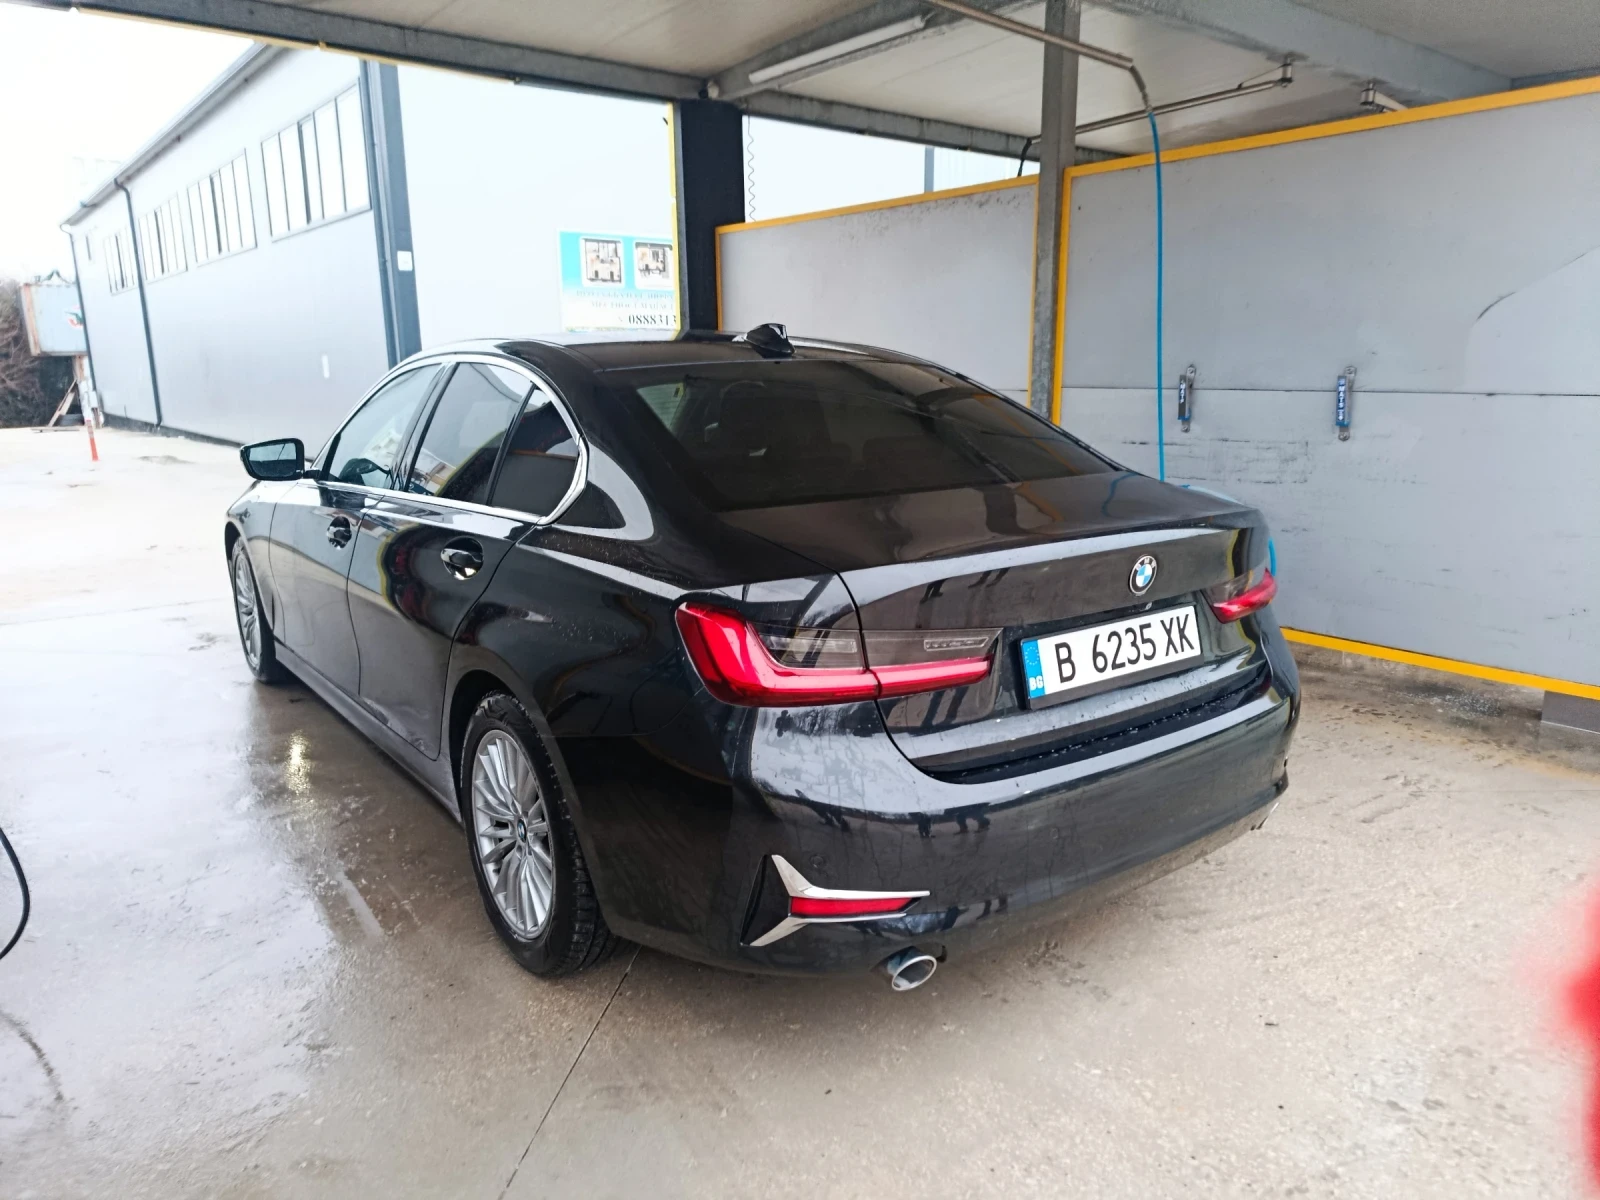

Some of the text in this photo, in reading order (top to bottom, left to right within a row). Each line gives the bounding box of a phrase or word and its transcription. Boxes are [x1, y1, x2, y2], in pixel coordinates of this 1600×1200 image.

[1054, 613, 1195, 684] B 6235 XK
[1028, 675, 1044, 691] BG
